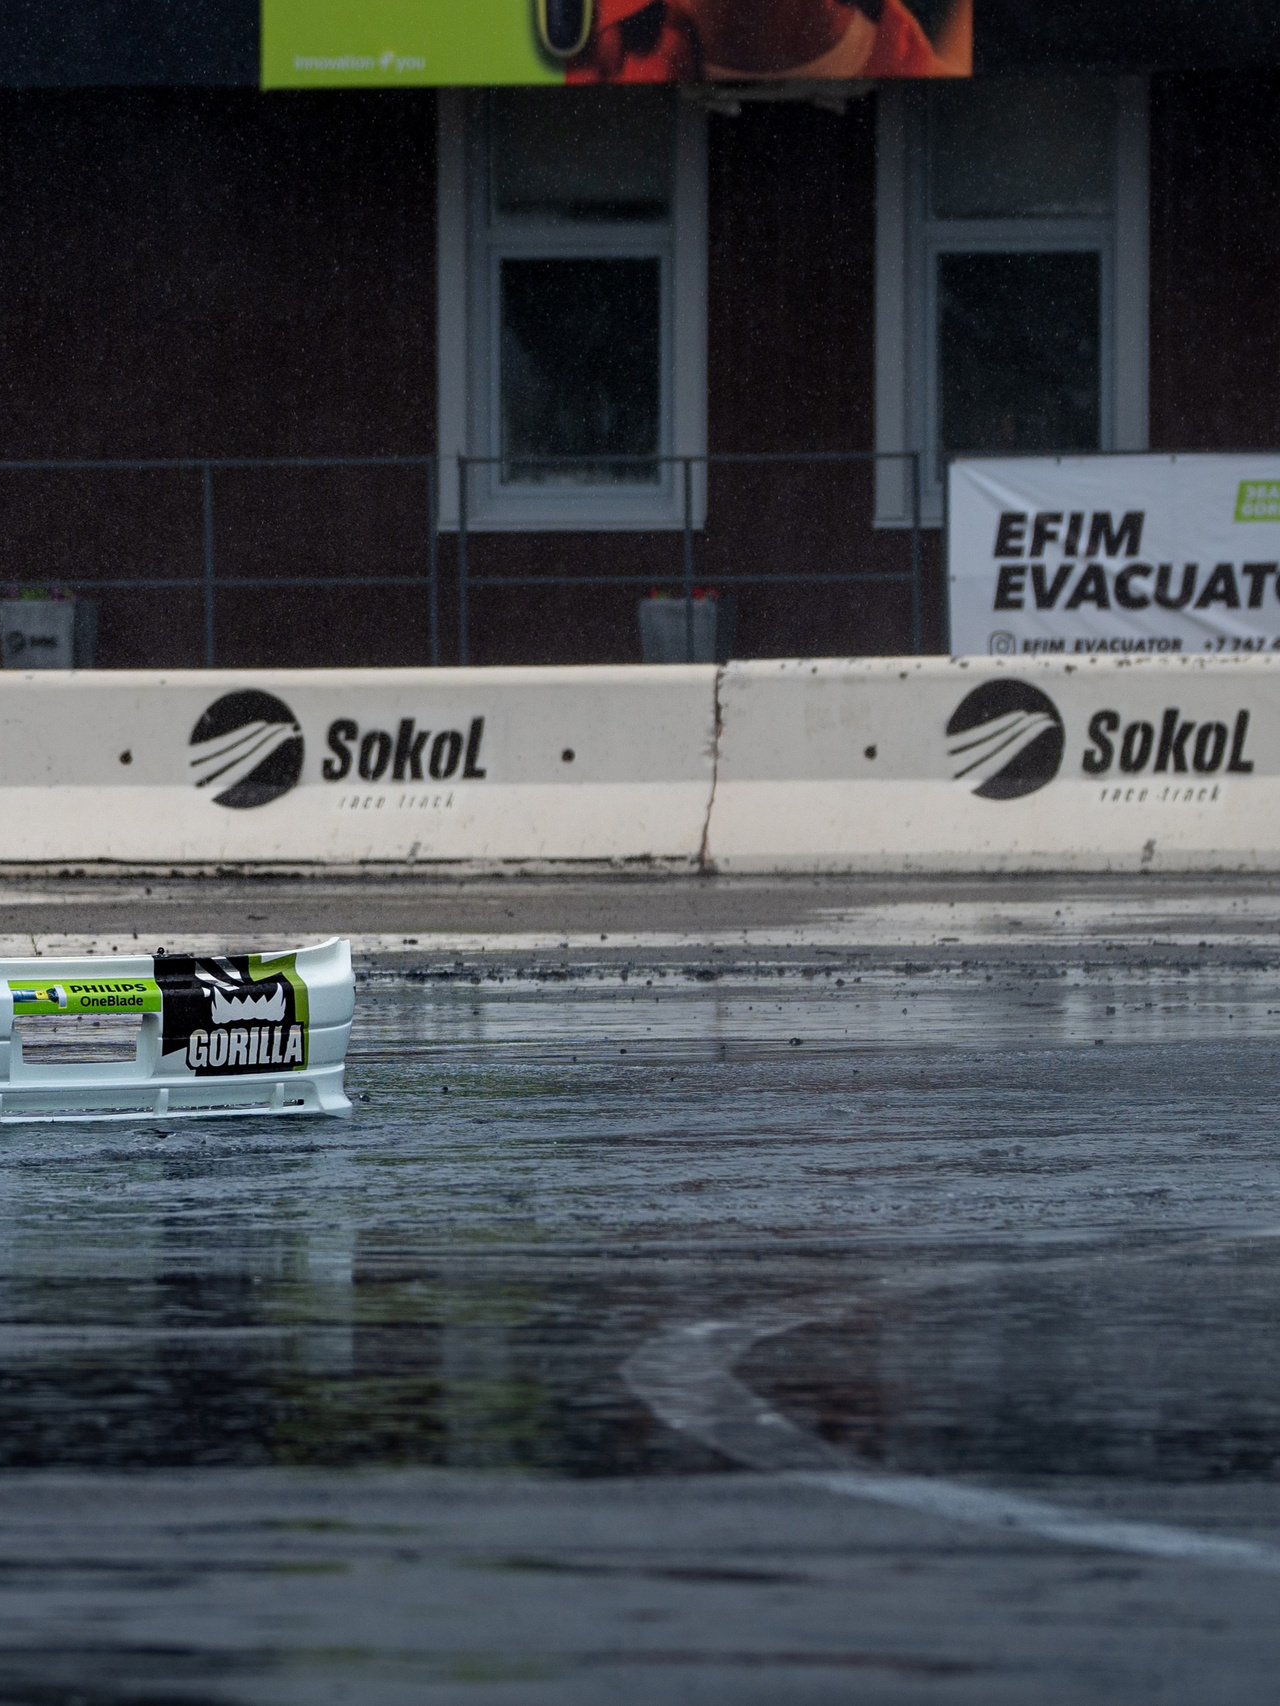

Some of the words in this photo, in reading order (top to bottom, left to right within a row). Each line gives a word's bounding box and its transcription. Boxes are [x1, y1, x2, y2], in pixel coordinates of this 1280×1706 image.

[293, 55, 375, 71] innovation
[396, 56, 426, 74] you
[994, 511, 1145, 558] EFIM
[994, 562, 1280, 611] EVACUAT
[337, 795, 386, 810] race
[399, 791, 454, 809] track
[1100, 787, 1148, 802] race
[1163, 784, 1221, 802] track
[69, 983, 147, 994] PHILIPS
[80, 994, 144, 1008] OneBlade
[188, 1025, 303, 1068] GORILLA
